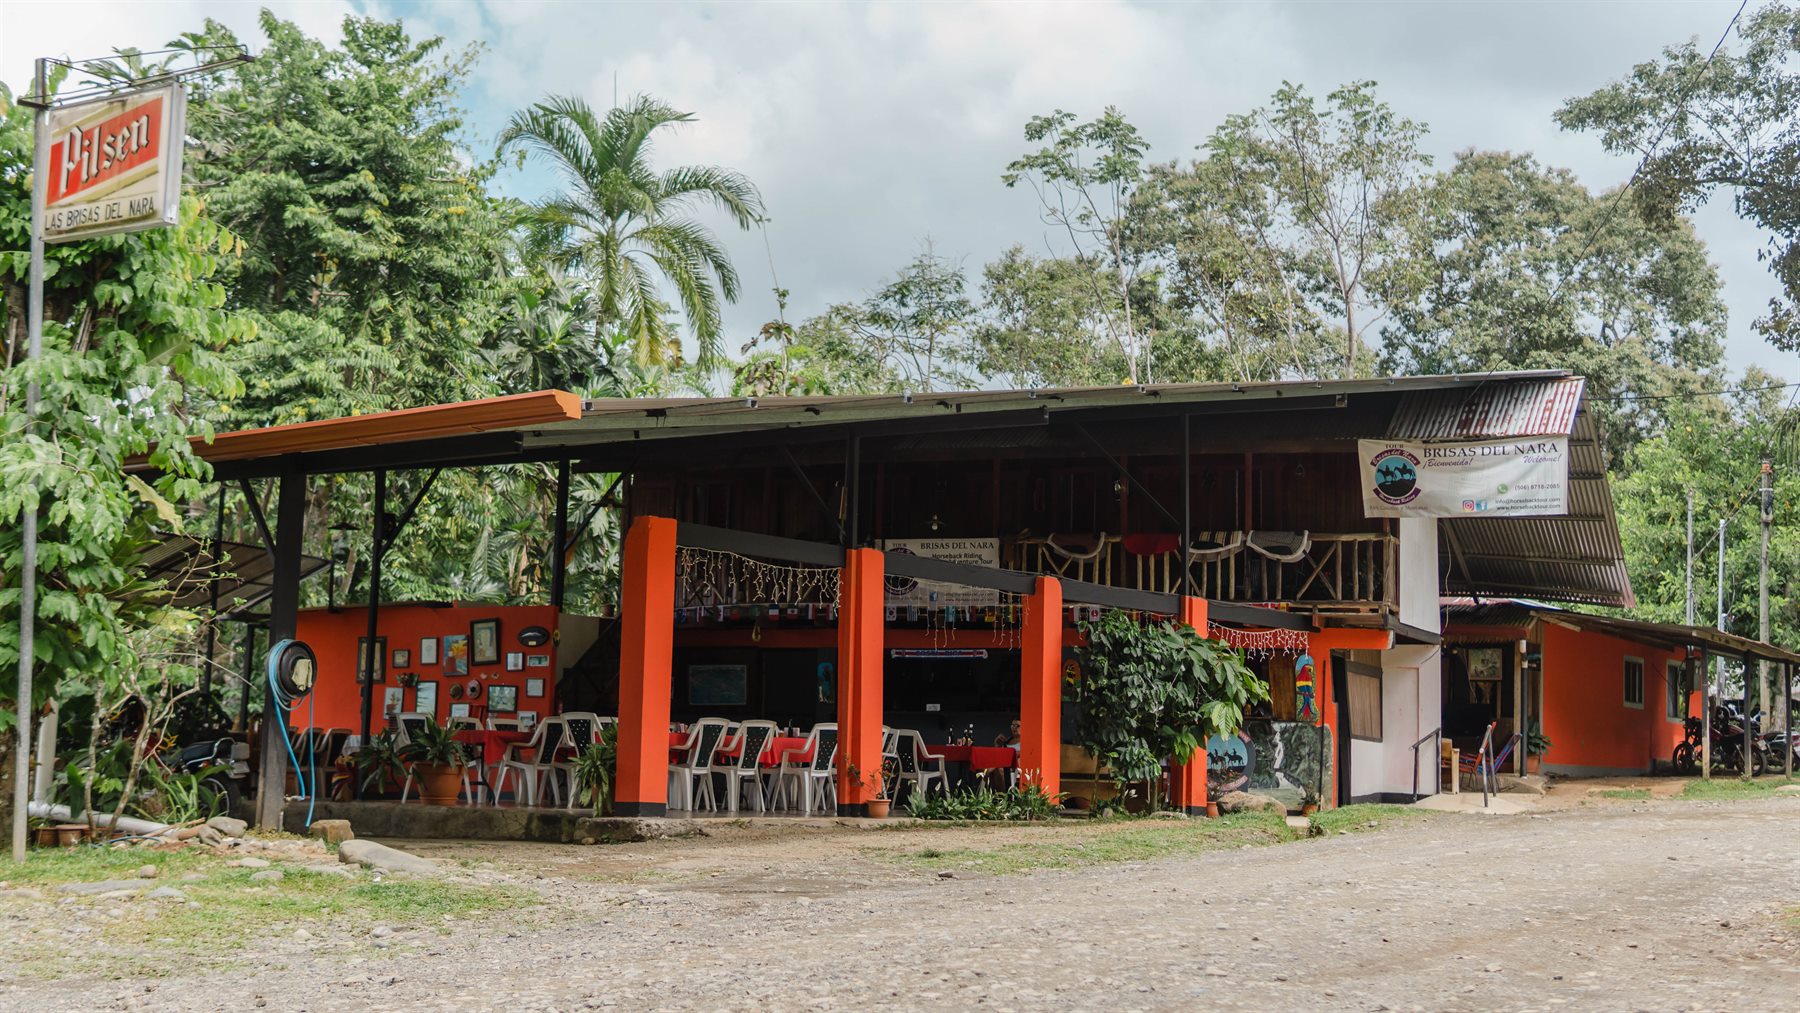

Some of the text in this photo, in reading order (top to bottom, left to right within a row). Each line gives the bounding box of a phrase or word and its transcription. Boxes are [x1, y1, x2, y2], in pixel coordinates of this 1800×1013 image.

[60, 114, 149, 198] Pilsen
[44, 196, 155, 231] LAS BRISAS DEL NARA
[1423, 442, 1559, 458] BRISAS DEL NARA
[1422, 457, 1474, 469] ¡Bienvenido!
[1522, 453, 1562, 464] Welcome!
[920, 542, 950, 550] BRISAS
[970, 541, 995, 549] NARA
[963, 552, 983, 560] Riding
